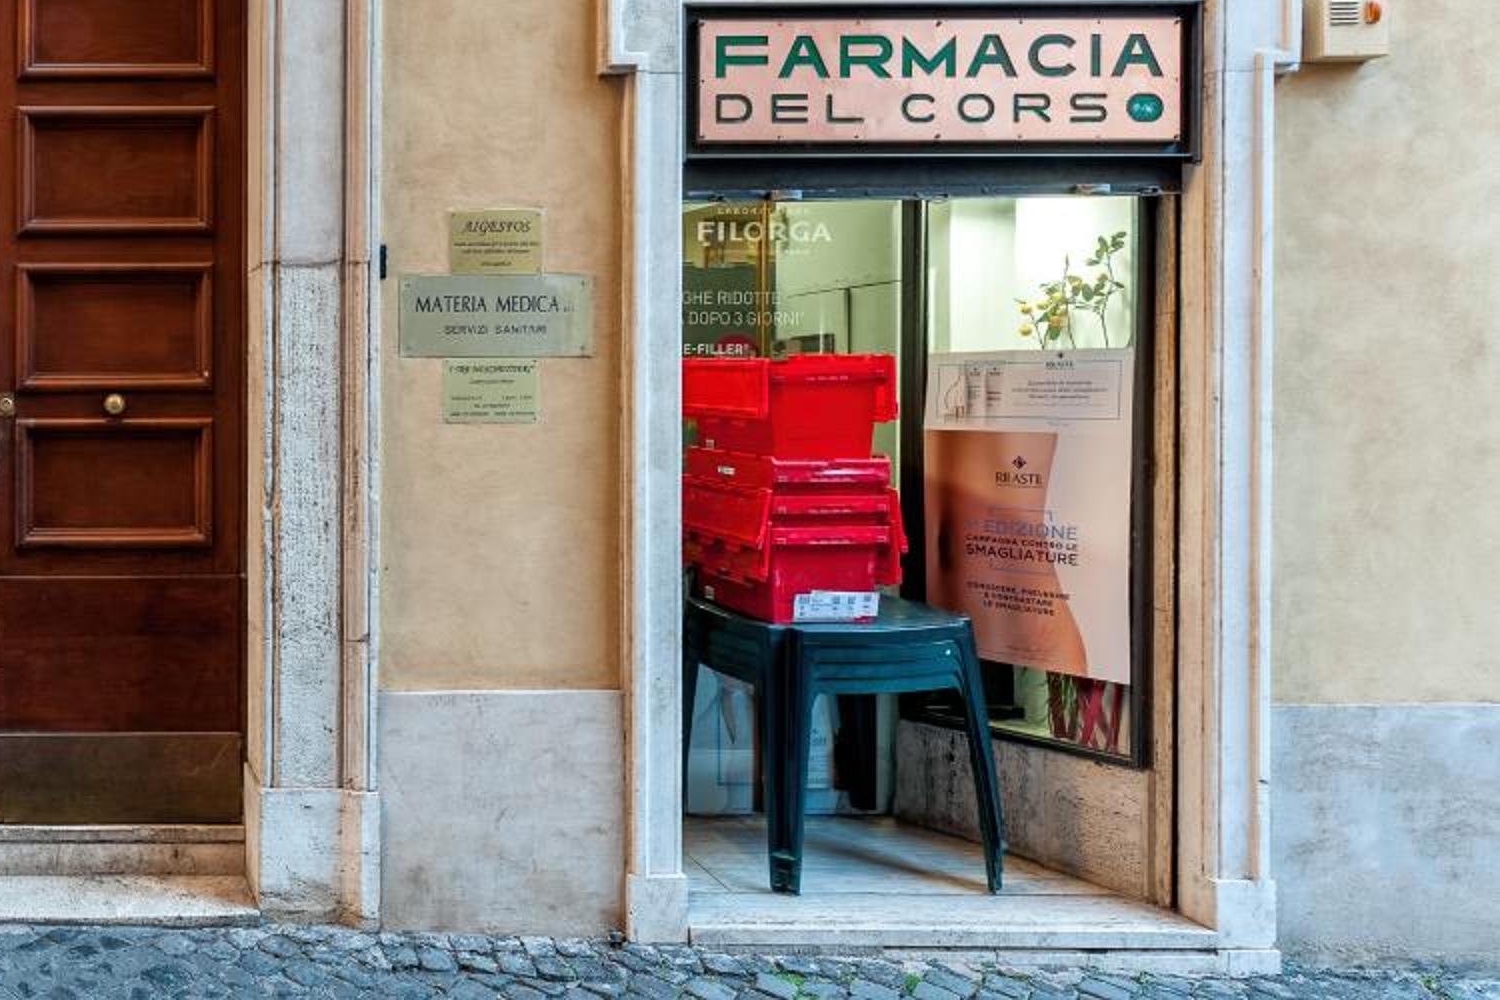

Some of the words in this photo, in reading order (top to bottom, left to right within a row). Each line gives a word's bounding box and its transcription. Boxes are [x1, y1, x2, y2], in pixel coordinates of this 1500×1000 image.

[715, 33, 1165, 80] FARMACIA
[715, 93, 864, 124] DEL
[900, 92, 1165, 124] CORSO
[697, 221, 833, 243] FILORGA
[415, 296, 487, 313] MATERIA
[495, 296, 559, 313] MEDICA
[717, 290, 781, 305] RIDOTTE
[688, 311, 731, 325] DOPO
[733, 311, 744, 326] 3
[965, 543, 1080, 567] SMAGLIATURE
